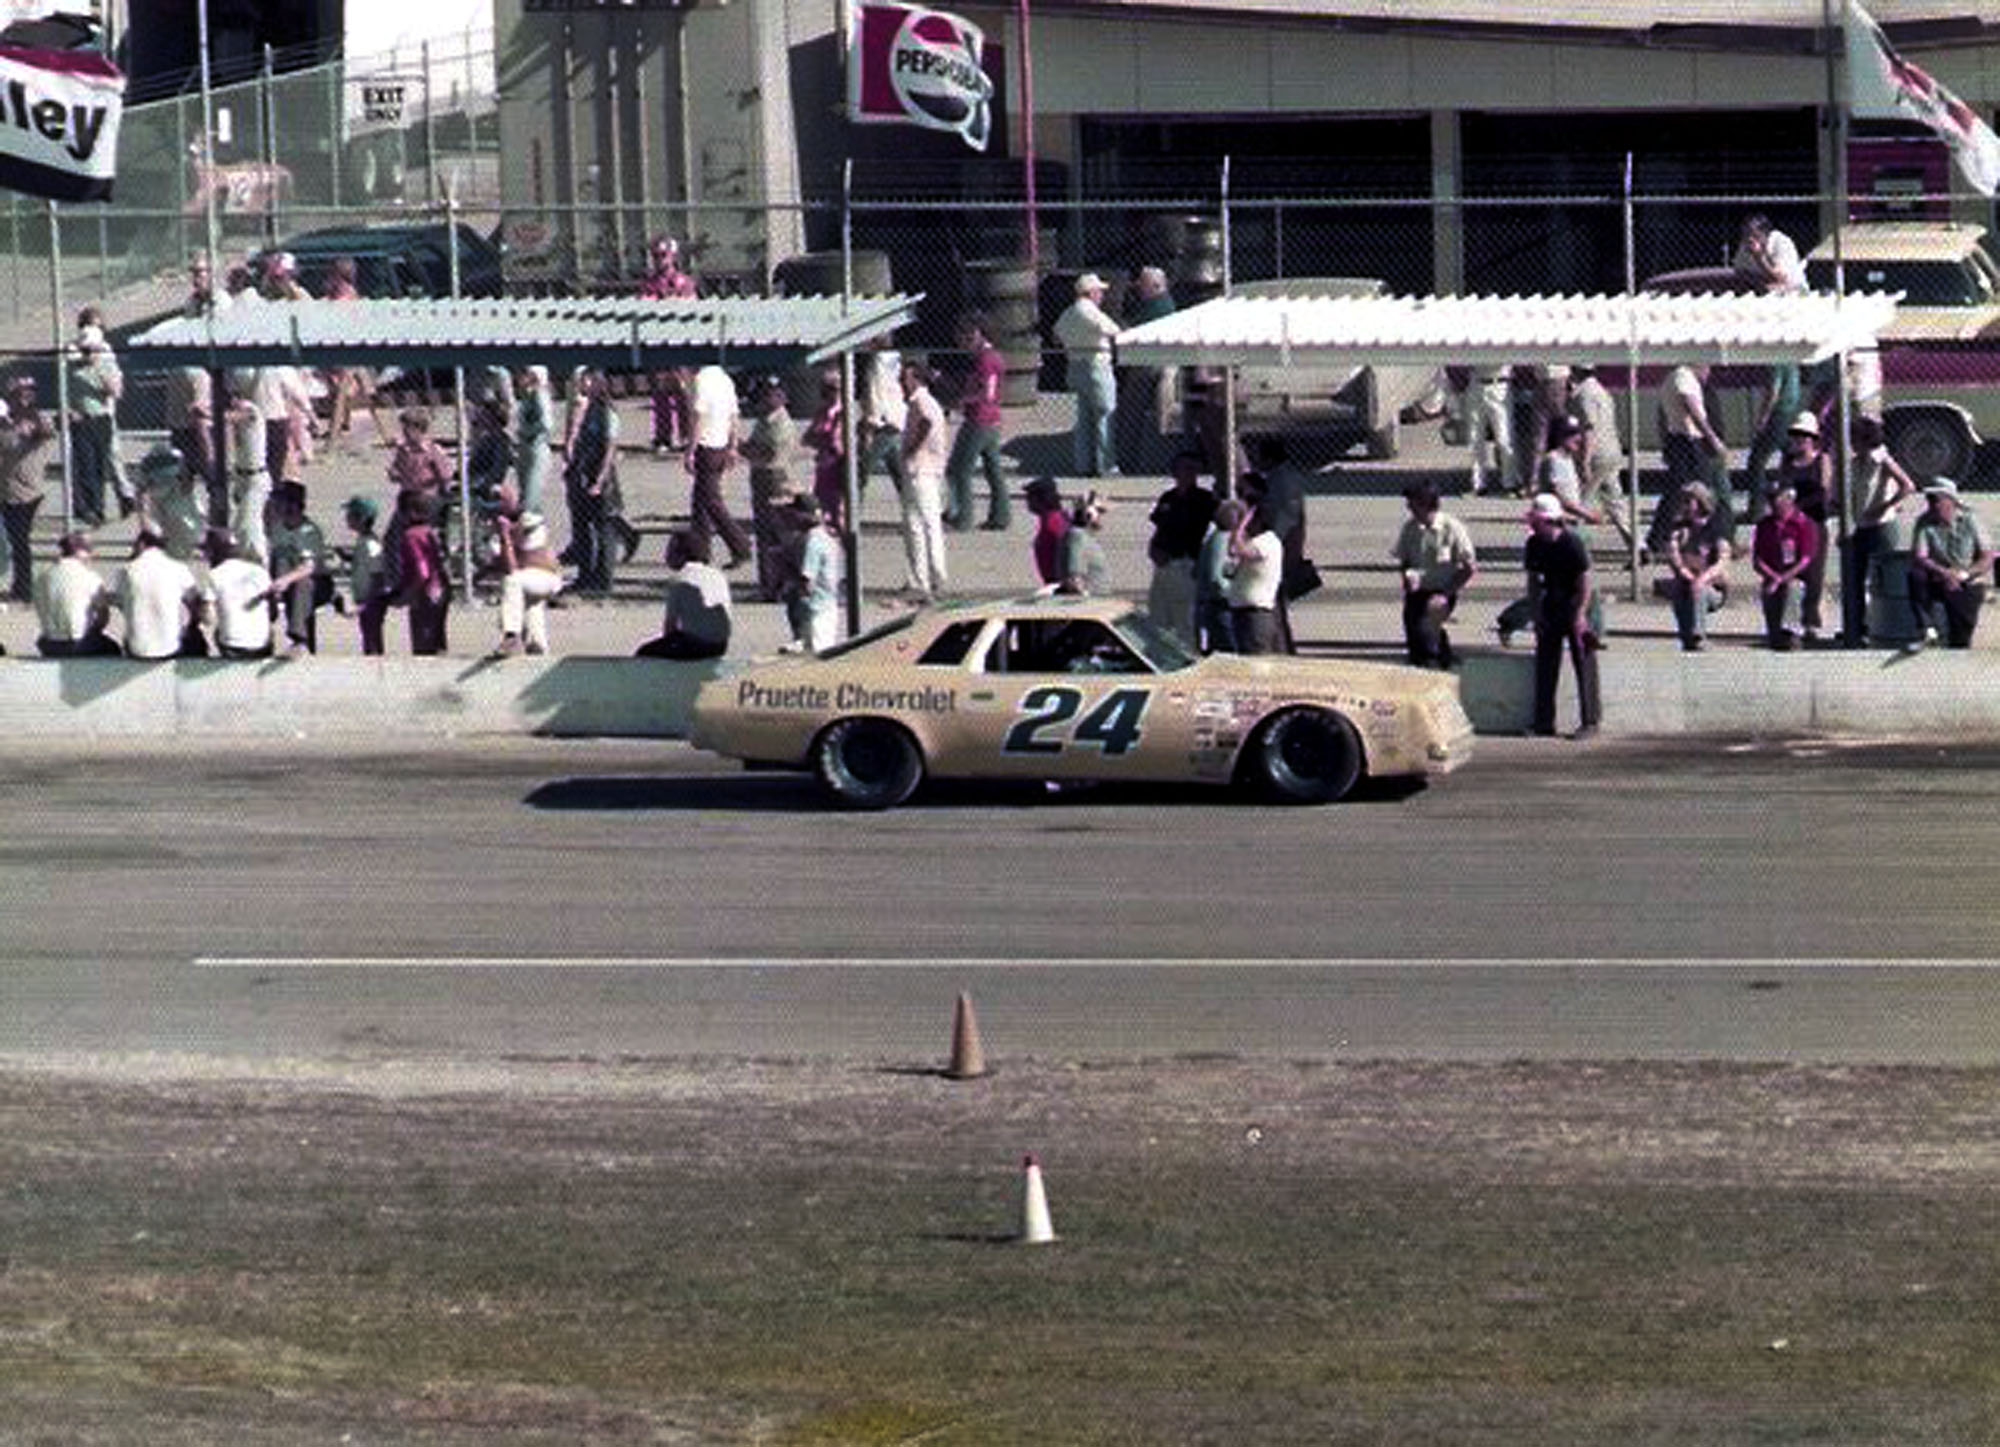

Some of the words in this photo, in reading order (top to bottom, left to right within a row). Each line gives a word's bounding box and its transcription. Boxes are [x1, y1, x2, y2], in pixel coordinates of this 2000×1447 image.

[363, 87, 404, 105] EXIT
[738, 680, 829, 709] Pruette
[836, 682, 956, 713] Chevrolet
[1002, 685, 1151, 756] 24
